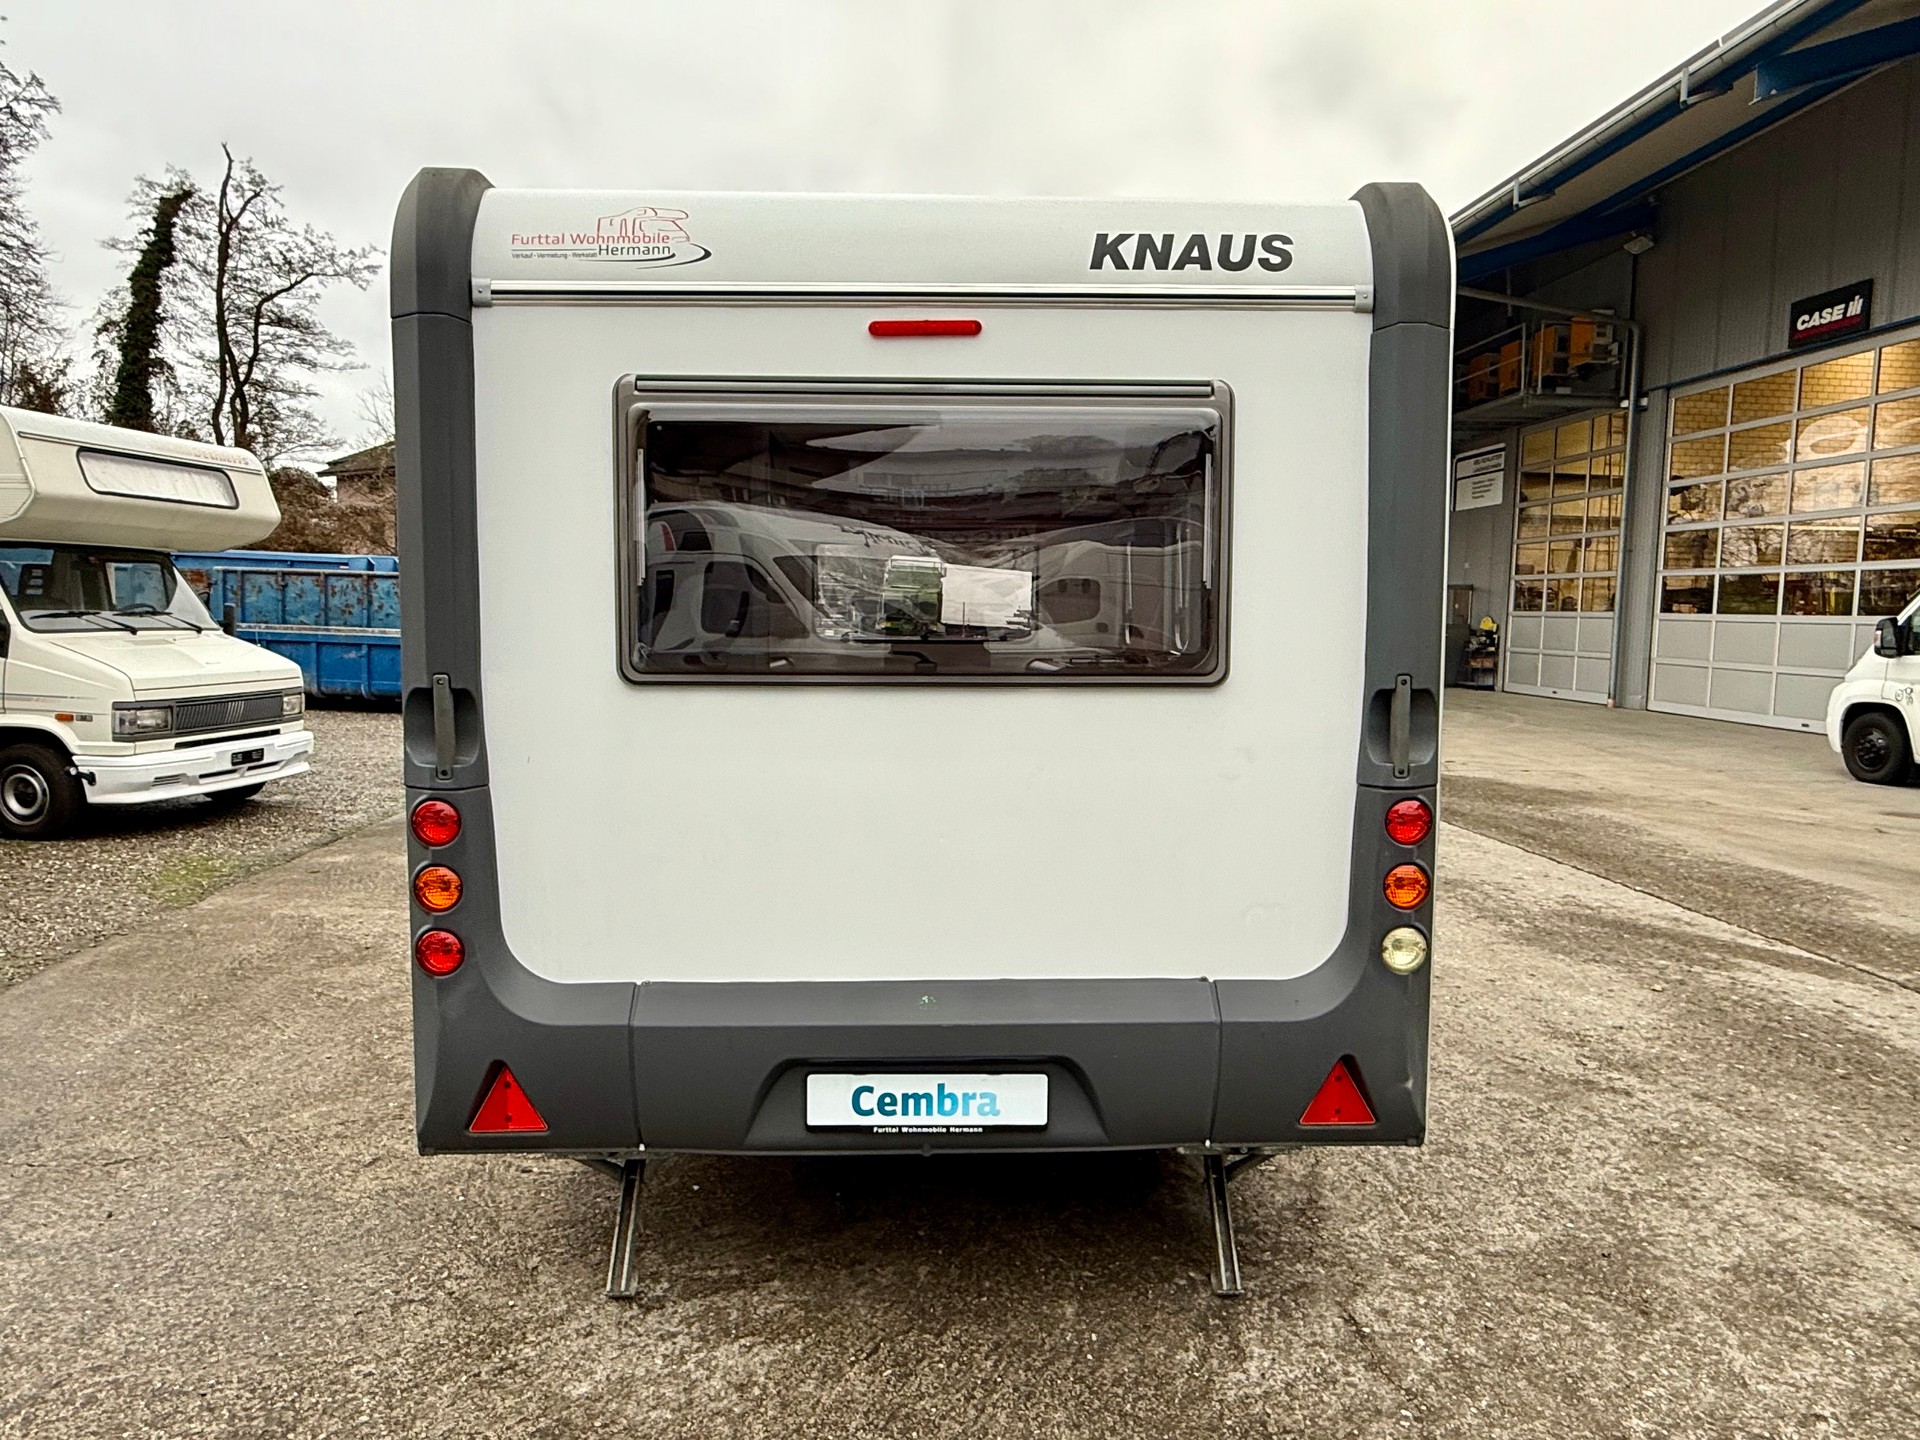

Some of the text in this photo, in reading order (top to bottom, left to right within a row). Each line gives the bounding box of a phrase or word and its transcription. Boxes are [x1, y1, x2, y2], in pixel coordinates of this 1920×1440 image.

[511, 232, 670, 245] Furttal Wohnmobile
[598, 244, 671, 256] Hermann
[1089, 233, 1294, 272] KNAUS
[1796, 303, 1846, 331] CASE
[851, 1083, 1001, 1117] Cembra
